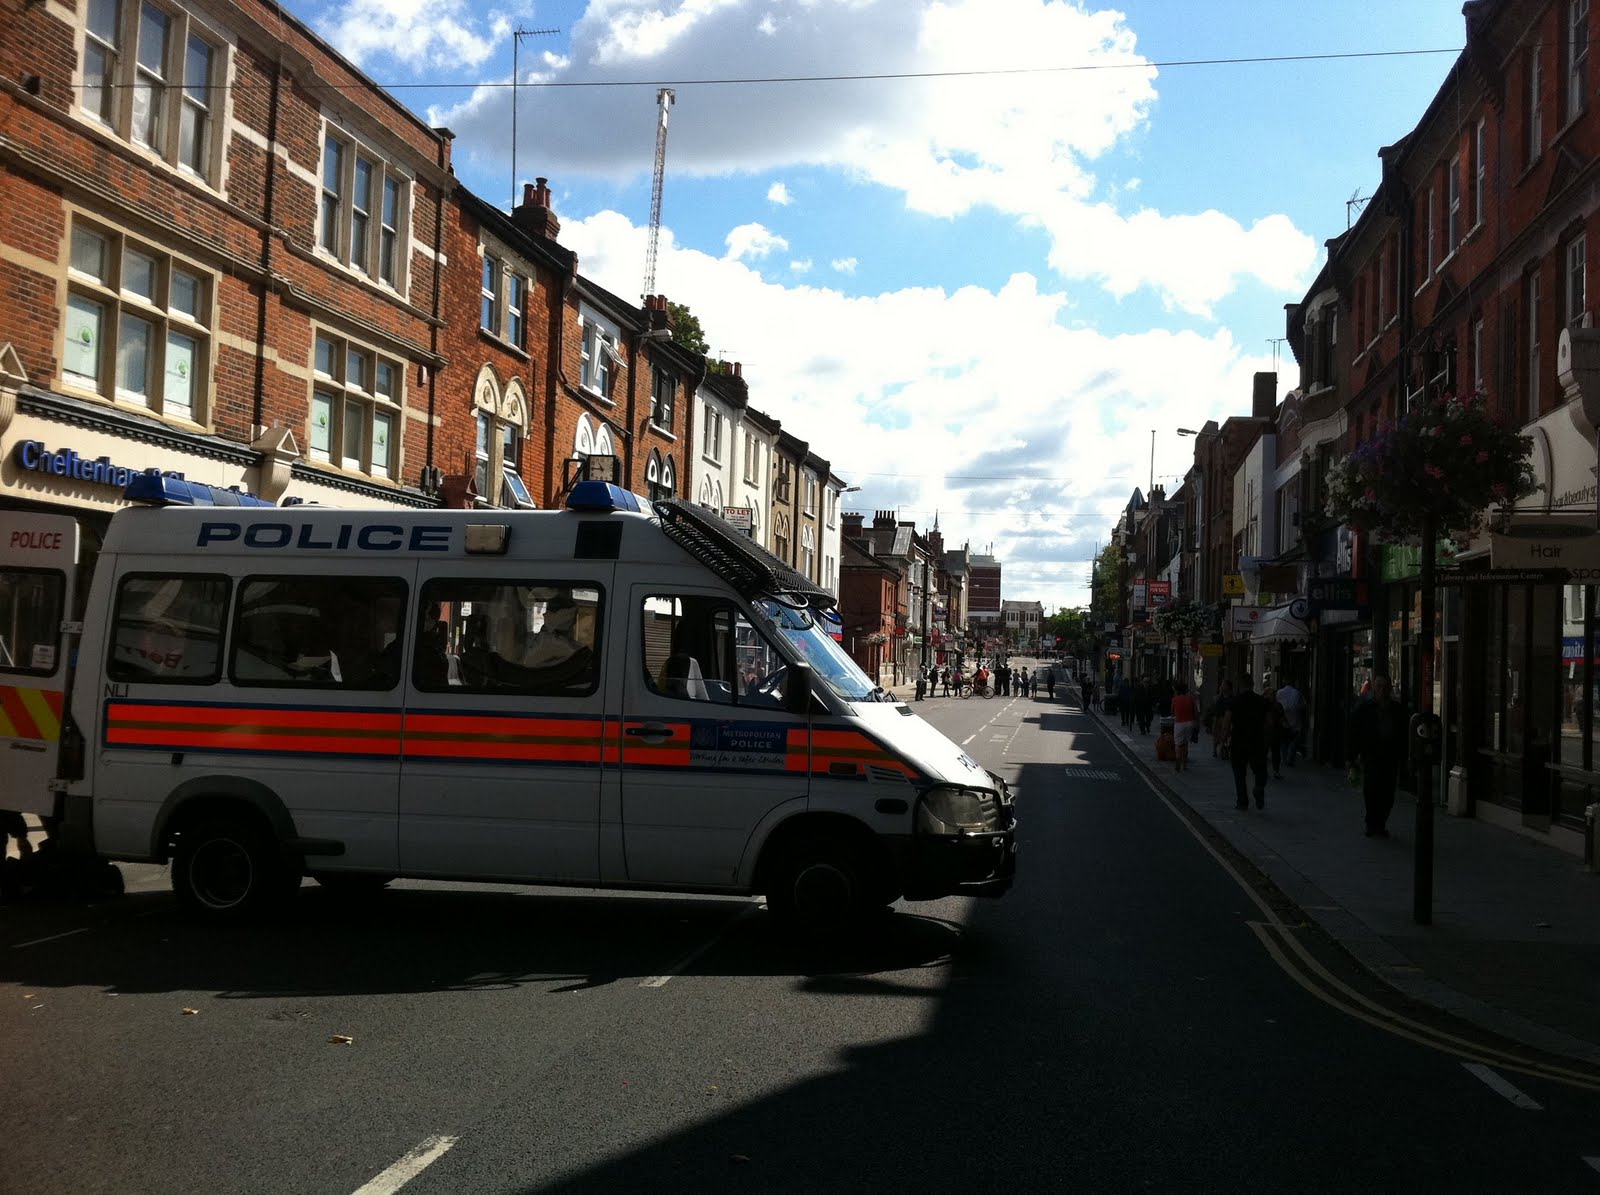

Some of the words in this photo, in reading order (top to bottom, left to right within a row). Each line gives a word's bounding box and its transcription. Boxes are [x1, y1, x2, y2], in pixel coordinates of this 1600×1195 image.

[10, 531, 62, 549] POLICE
[196, 522, 453, 551] POLICE
[1531, 544, 1561, 558] Hair
[1440, 573, 1464, 583] Library
[1465, 573, 1478, 581] and
[1478, 572, 1519, 581] Information
[1312, 583, 1352, 599] ellis
[722, 730, 782, 739] METROPOLITAN
[730, 739, 773, 749] POLICE
